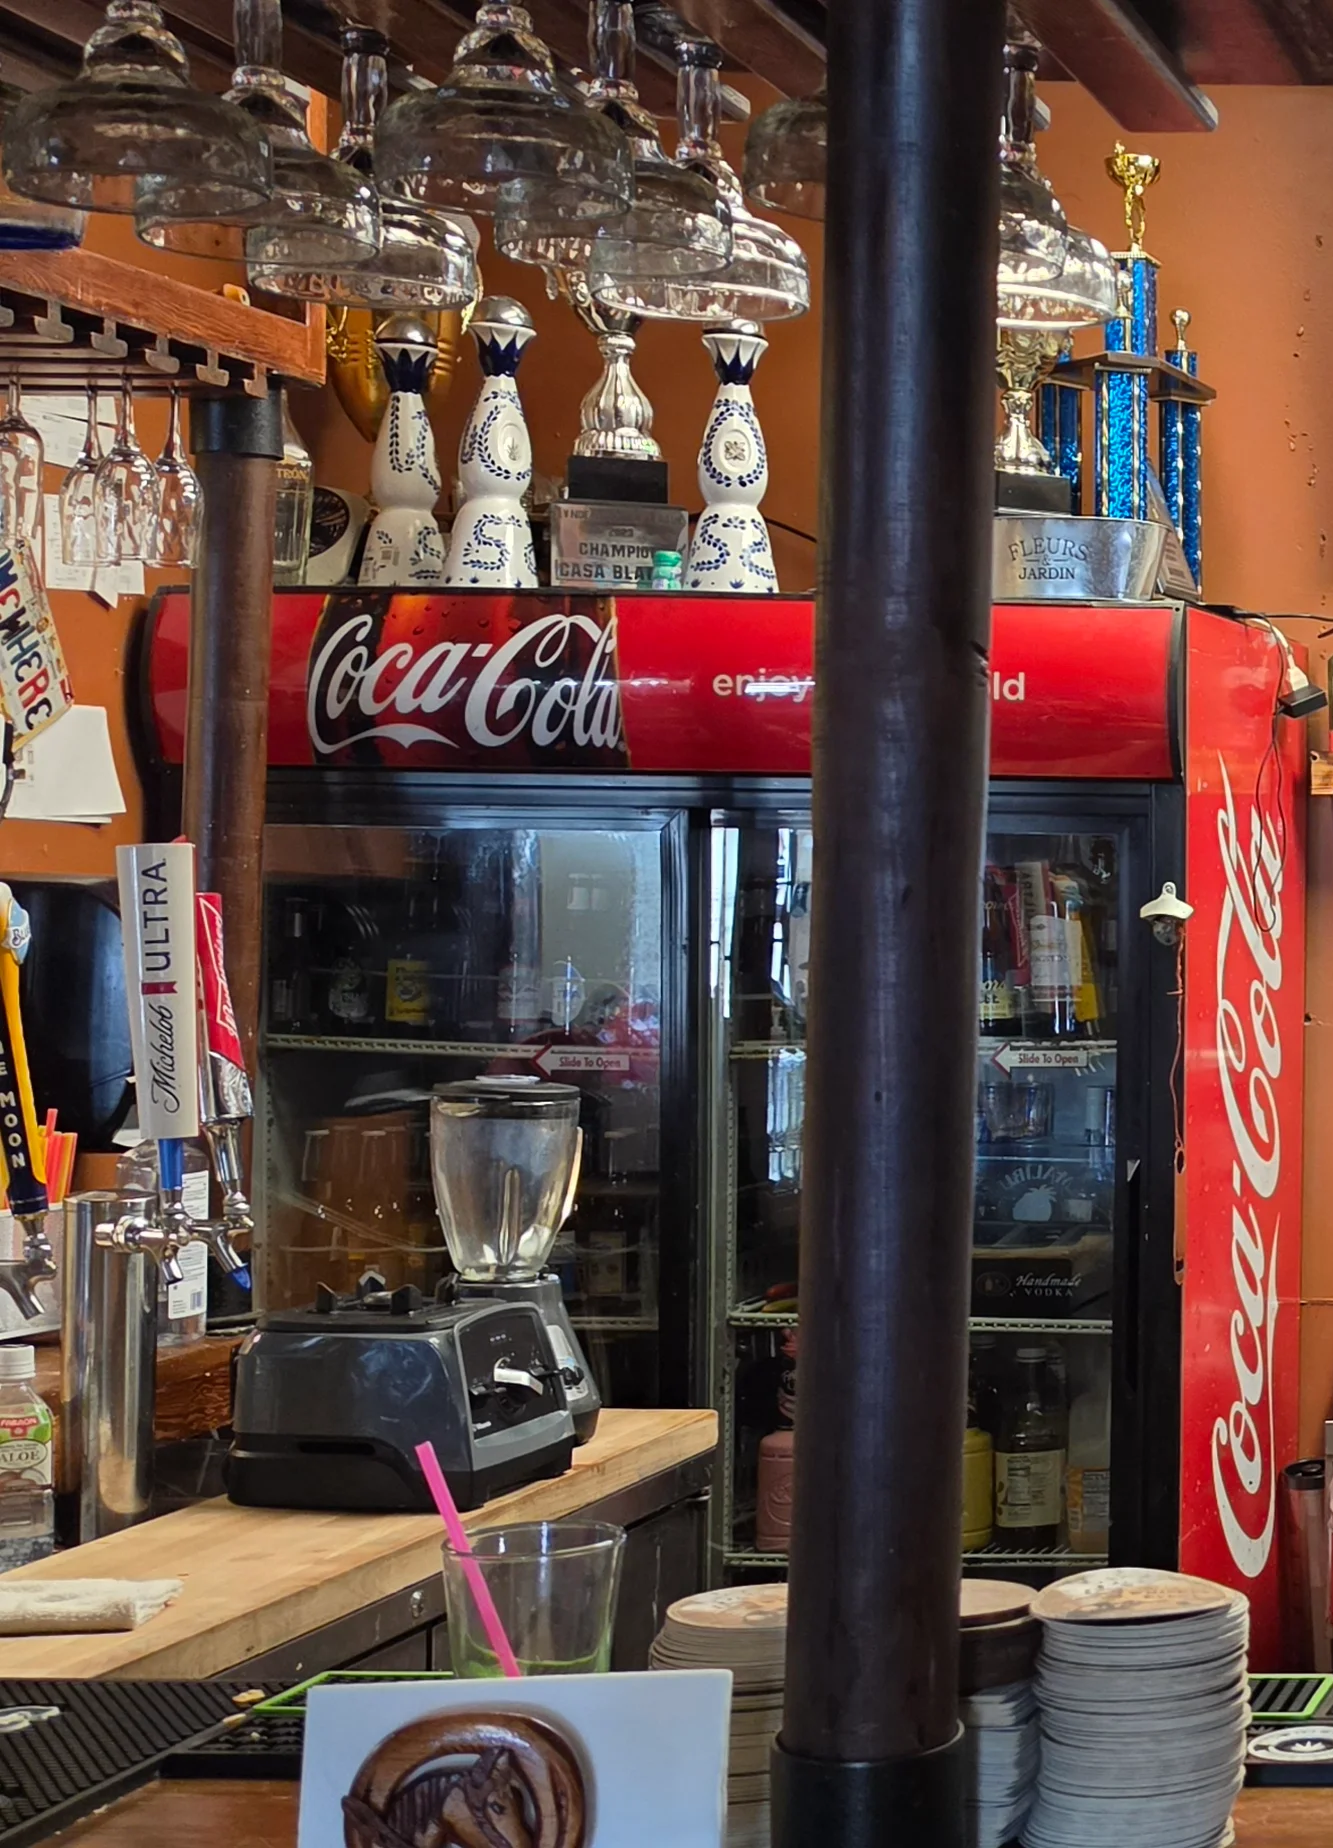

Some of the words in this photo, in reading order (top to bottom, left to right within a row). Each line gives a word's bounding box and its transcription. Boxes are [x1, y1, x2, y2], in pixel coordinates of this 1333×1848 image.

[579, 542, 653, 559] CHAMPIO
[1009, 537, 1091, 562] FLEURS
[559, 562, 605, 579] CASA
[1018, 566, 1076, 581] JARDIN
[141, 857, 172, 974] ULTRA
[151, 1003, 182, 1113] Michelob
[559, 1056, 582, 1069] Slide
[583, 1057, 594, 1068] To
[595, 1057, 621, 1070] Open
[1018, 1053, 1041, 1065] Slide
[1042, 1053, 1053, 1065] To
[1054, 1054, 1079, 1067] Open
[1212, 750, 1284, 1578] Coca-Cola
[1015, 1272, 1082, 1288] Handmade
[1024, 1287, 1074, 1297] VODKA
[0, 1450, 41, 1463] ALOE
